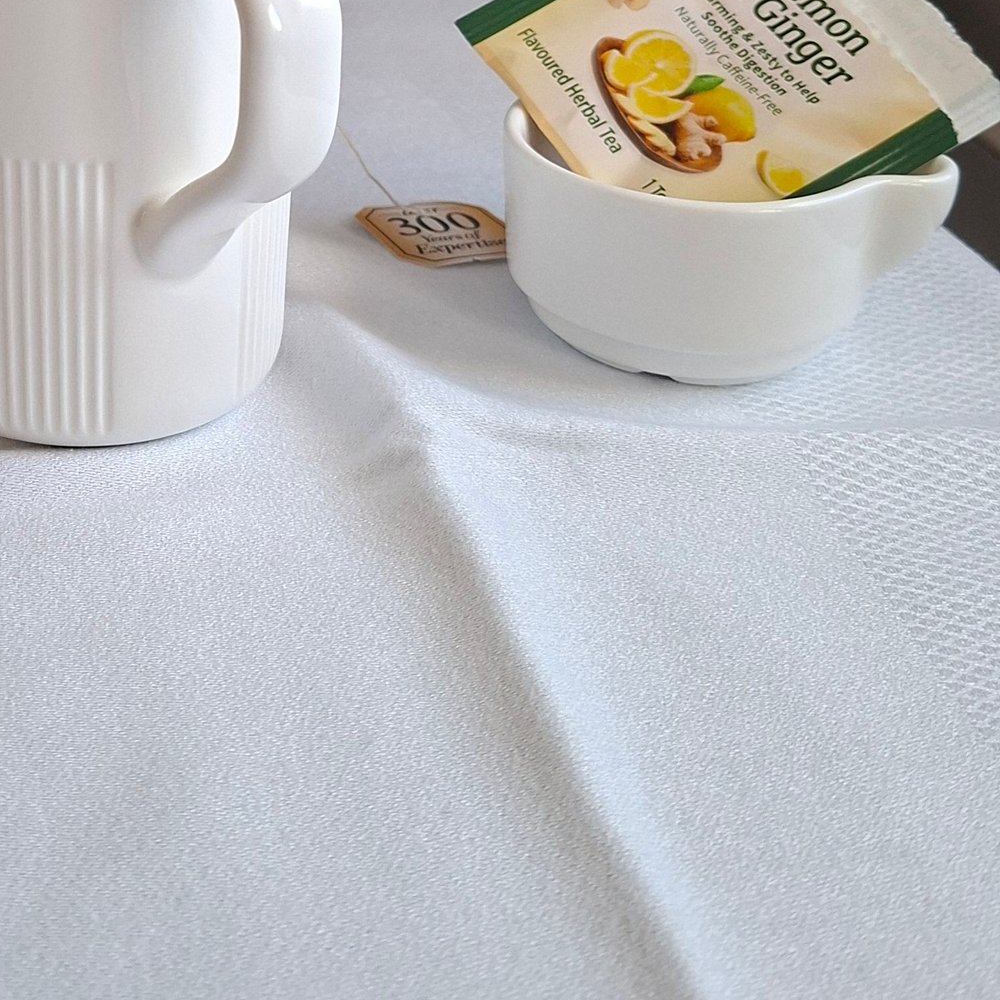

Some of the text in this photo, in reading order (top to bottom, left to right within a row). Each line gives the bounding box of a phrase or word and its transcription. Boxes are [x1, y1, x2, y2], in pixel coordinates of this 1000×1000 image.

[516, 27, 622, 154] Flavoured Herbal Tea
[674, 6, 783, 117] Naturally Caffeine-Free
[701, 11, 787, 97] Soothe Digestion
[742, 32, 754, 43] &
[750, 40, 783, 71] Zesty
[780, 69, 795, 83] to
[792, 80, 821, 105] Help
[387, 211, 480, 237] 300
